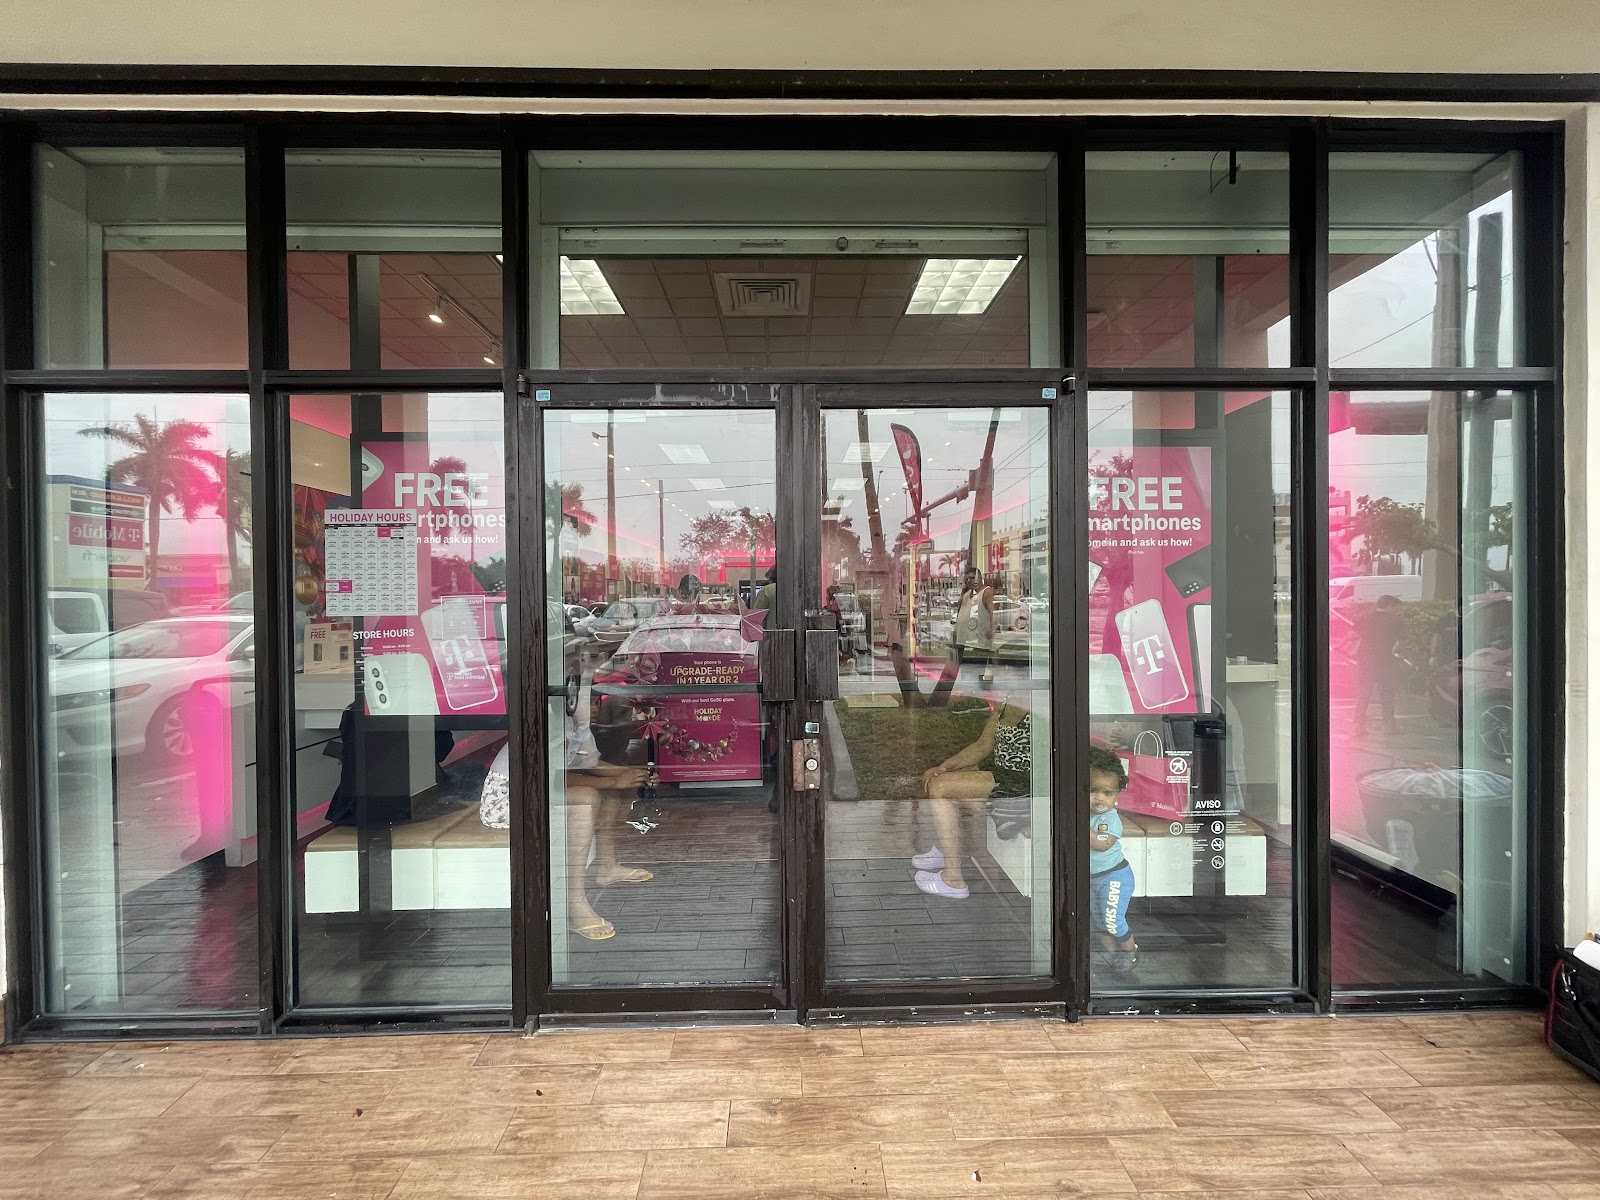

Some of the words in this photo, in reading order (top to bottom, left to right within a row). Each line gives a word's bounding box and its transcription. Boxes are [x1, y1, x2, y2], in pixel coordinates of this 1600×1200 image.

[394, 472, 489, 507] FREE
[1089, 477, 1183, 511] FREE
[330, 513, 374, 522] HOLIDAY
[377, 513, 412, 522] HOURS
[417, 510, 505, 532] rtphones
[1088, 514, 1202, 535] martphones
[424, 535, 441, 544] and
[443, 535, 460, 544] ask
[462, 536, 473, 544] us
[475, 535, 499, 544] how!
[1109, 538, 1117, 547] in
[1120, 538, 1137, 546] and
[1140, 538, 1156, 546] ask
[1171, 538, 1193, 546] how!
[310, 630, 326, 639] FREE
[353, 630, 382, 640] STORE
[383, 629, 415, 638] HOURS
[670, 666, 745, 676] UPGRADE-READY
[719, 676, 732, 684] OR
[733, 675, 739, 684] 2
[1195, 800, 1221, 809] AVISO
[1107, 880, 1120, 908] BABY
